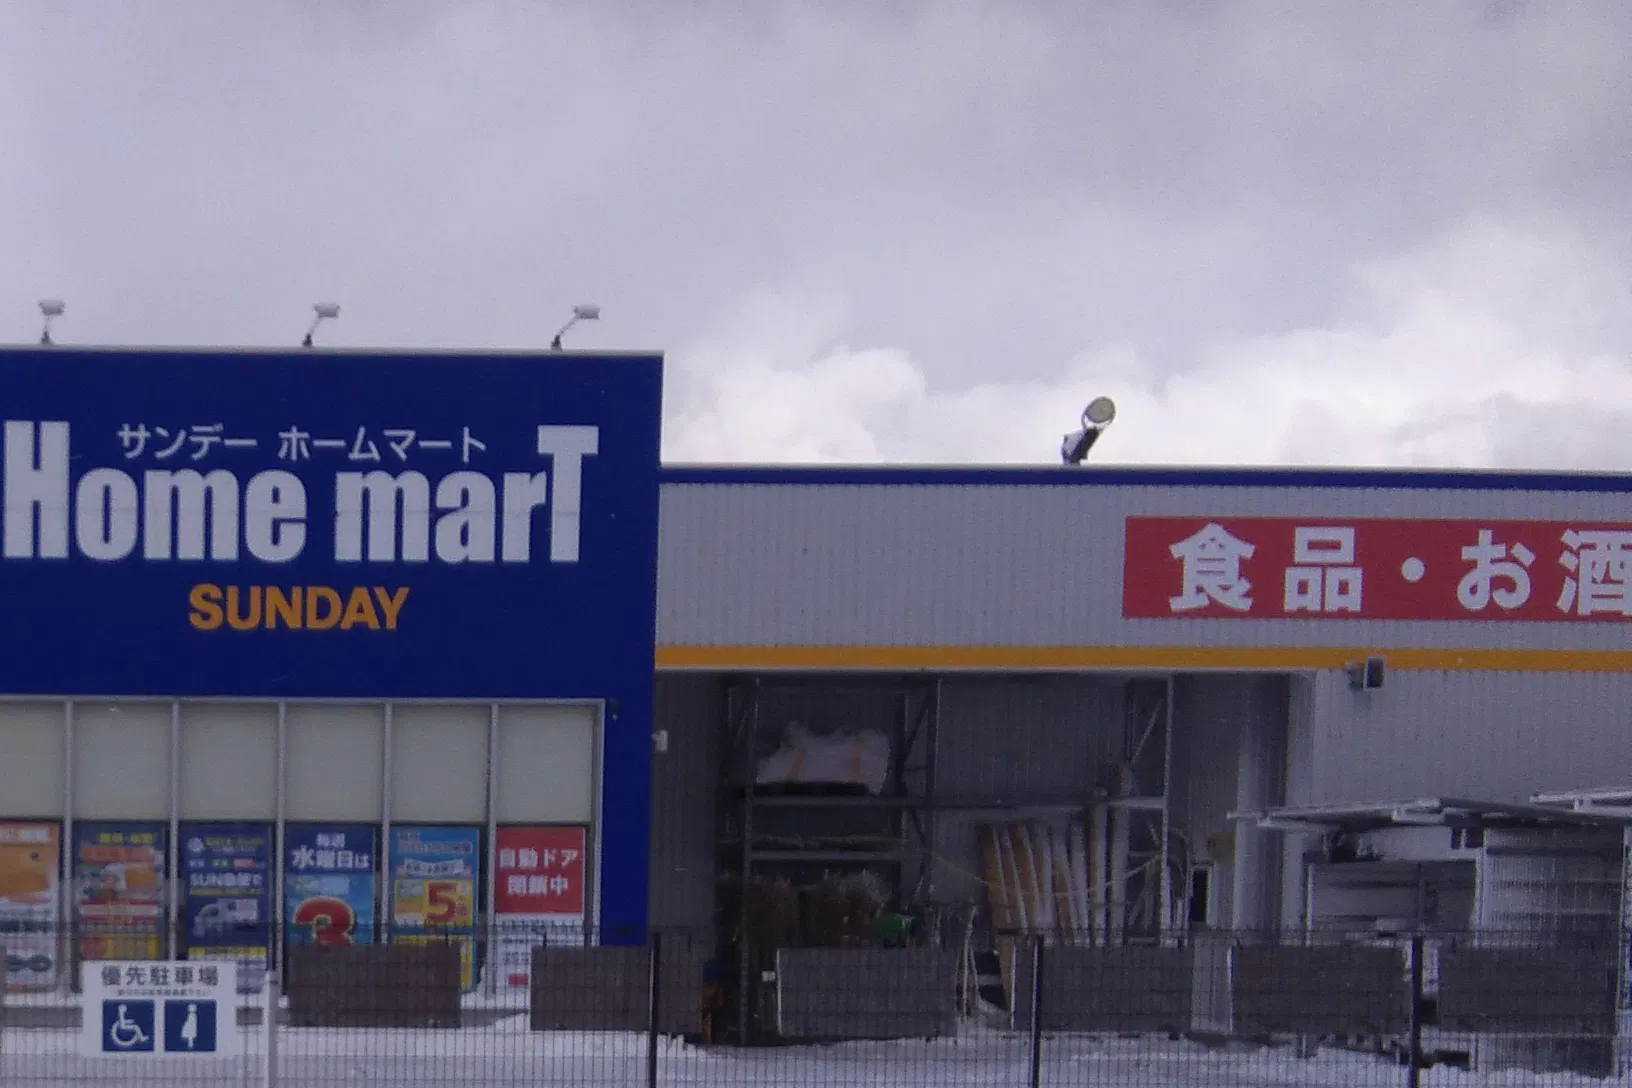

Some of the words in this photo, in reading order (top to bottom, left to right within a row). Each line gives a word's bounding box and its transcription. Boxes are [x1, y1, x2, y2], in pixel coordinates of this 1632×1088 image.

[117, 422, 258, 462] サンデー
[277, 425, 487, 462] ホームマート
[2, 419, 307, 563] Home
[187, 581, 411, 632] SUNDAY
[499, 847, 579, 869] 自動ドア
[101, 964, 219, 986] 優先駐車場
